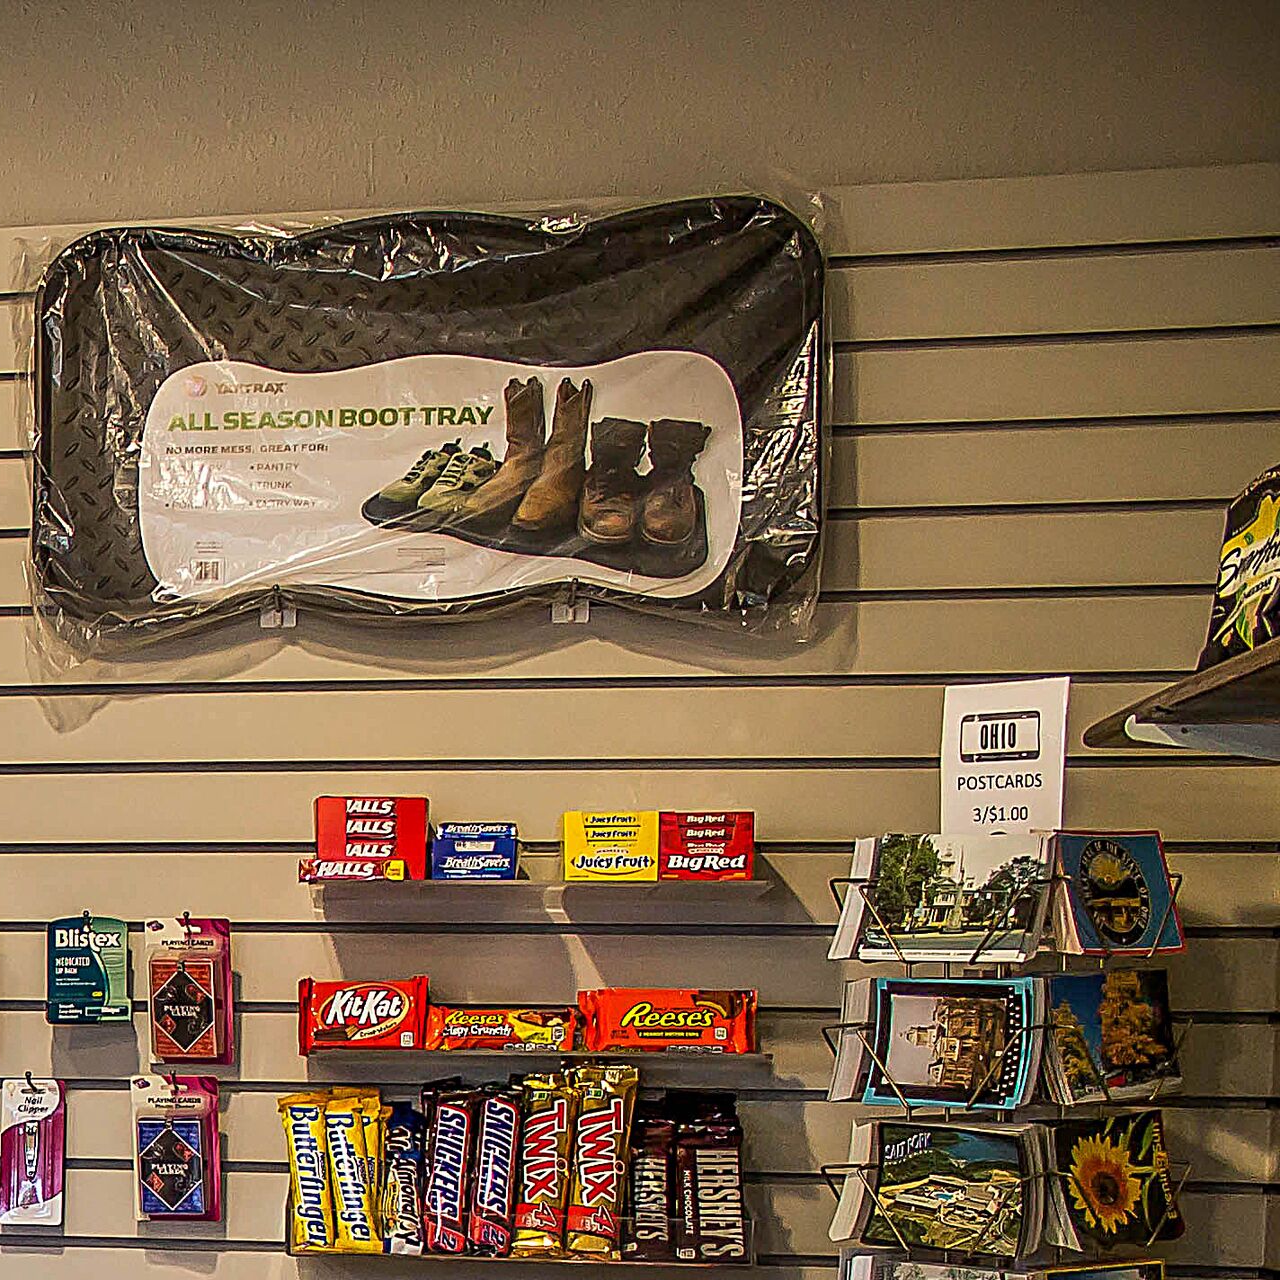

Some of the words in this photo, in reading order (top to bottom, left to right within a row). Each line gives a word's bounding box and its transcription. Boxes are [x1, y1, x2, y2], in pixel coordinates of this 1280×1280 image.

[168, 412, 220, 431] ALL
[223, 409, 333, 430] SEASON
[339, 407, 416, 427] BOOT
[420, 406, 493, 426] TRAY
[166, 446, 181, 455] NO
[184, 445, 219, 454] MORE
[260, 444, 298, 453] GREAT
[980, 722, 1017, 750] OHIO
[957, 773, 1043, 791] POSTCARDS
[590, 816, 611, 825] Juicy
[612, 815, 633, 824] Fruit
[705, 814, 726, 823] Red
[972, 806, 1029, 825] 3/$1.00
[591, 830, 612, 838] Juicy
[613, 829, 633, 838] Fruit
[705, 828, 726, 837] Red
[316, 861, 376, 878] HALLS
[576, 856, 612, 870] Juicy
[616, 855, 651, 869] Fruit
[668, 855, 703, 871] Big
[703, 854, 747, 869] Red
[55, 928, 121, 950] Blistex
[444, 1010, 504, 1025] Reese's
[621, 1002, 716, 1028] Reese's
[24, 1096, 42, 1104] Nail
[17, 1104, 49, 1114] Clipper
[435, 1108, 467, 1221] SNICKERS
[484, 1100, 516, 1218] SNICKERS
[288, 1106, 329, 1246] Butterfinger
[325, 1113, 372, 1242] Butterfinger
[696, 1149, 744, 1257] HERSHEY'S
